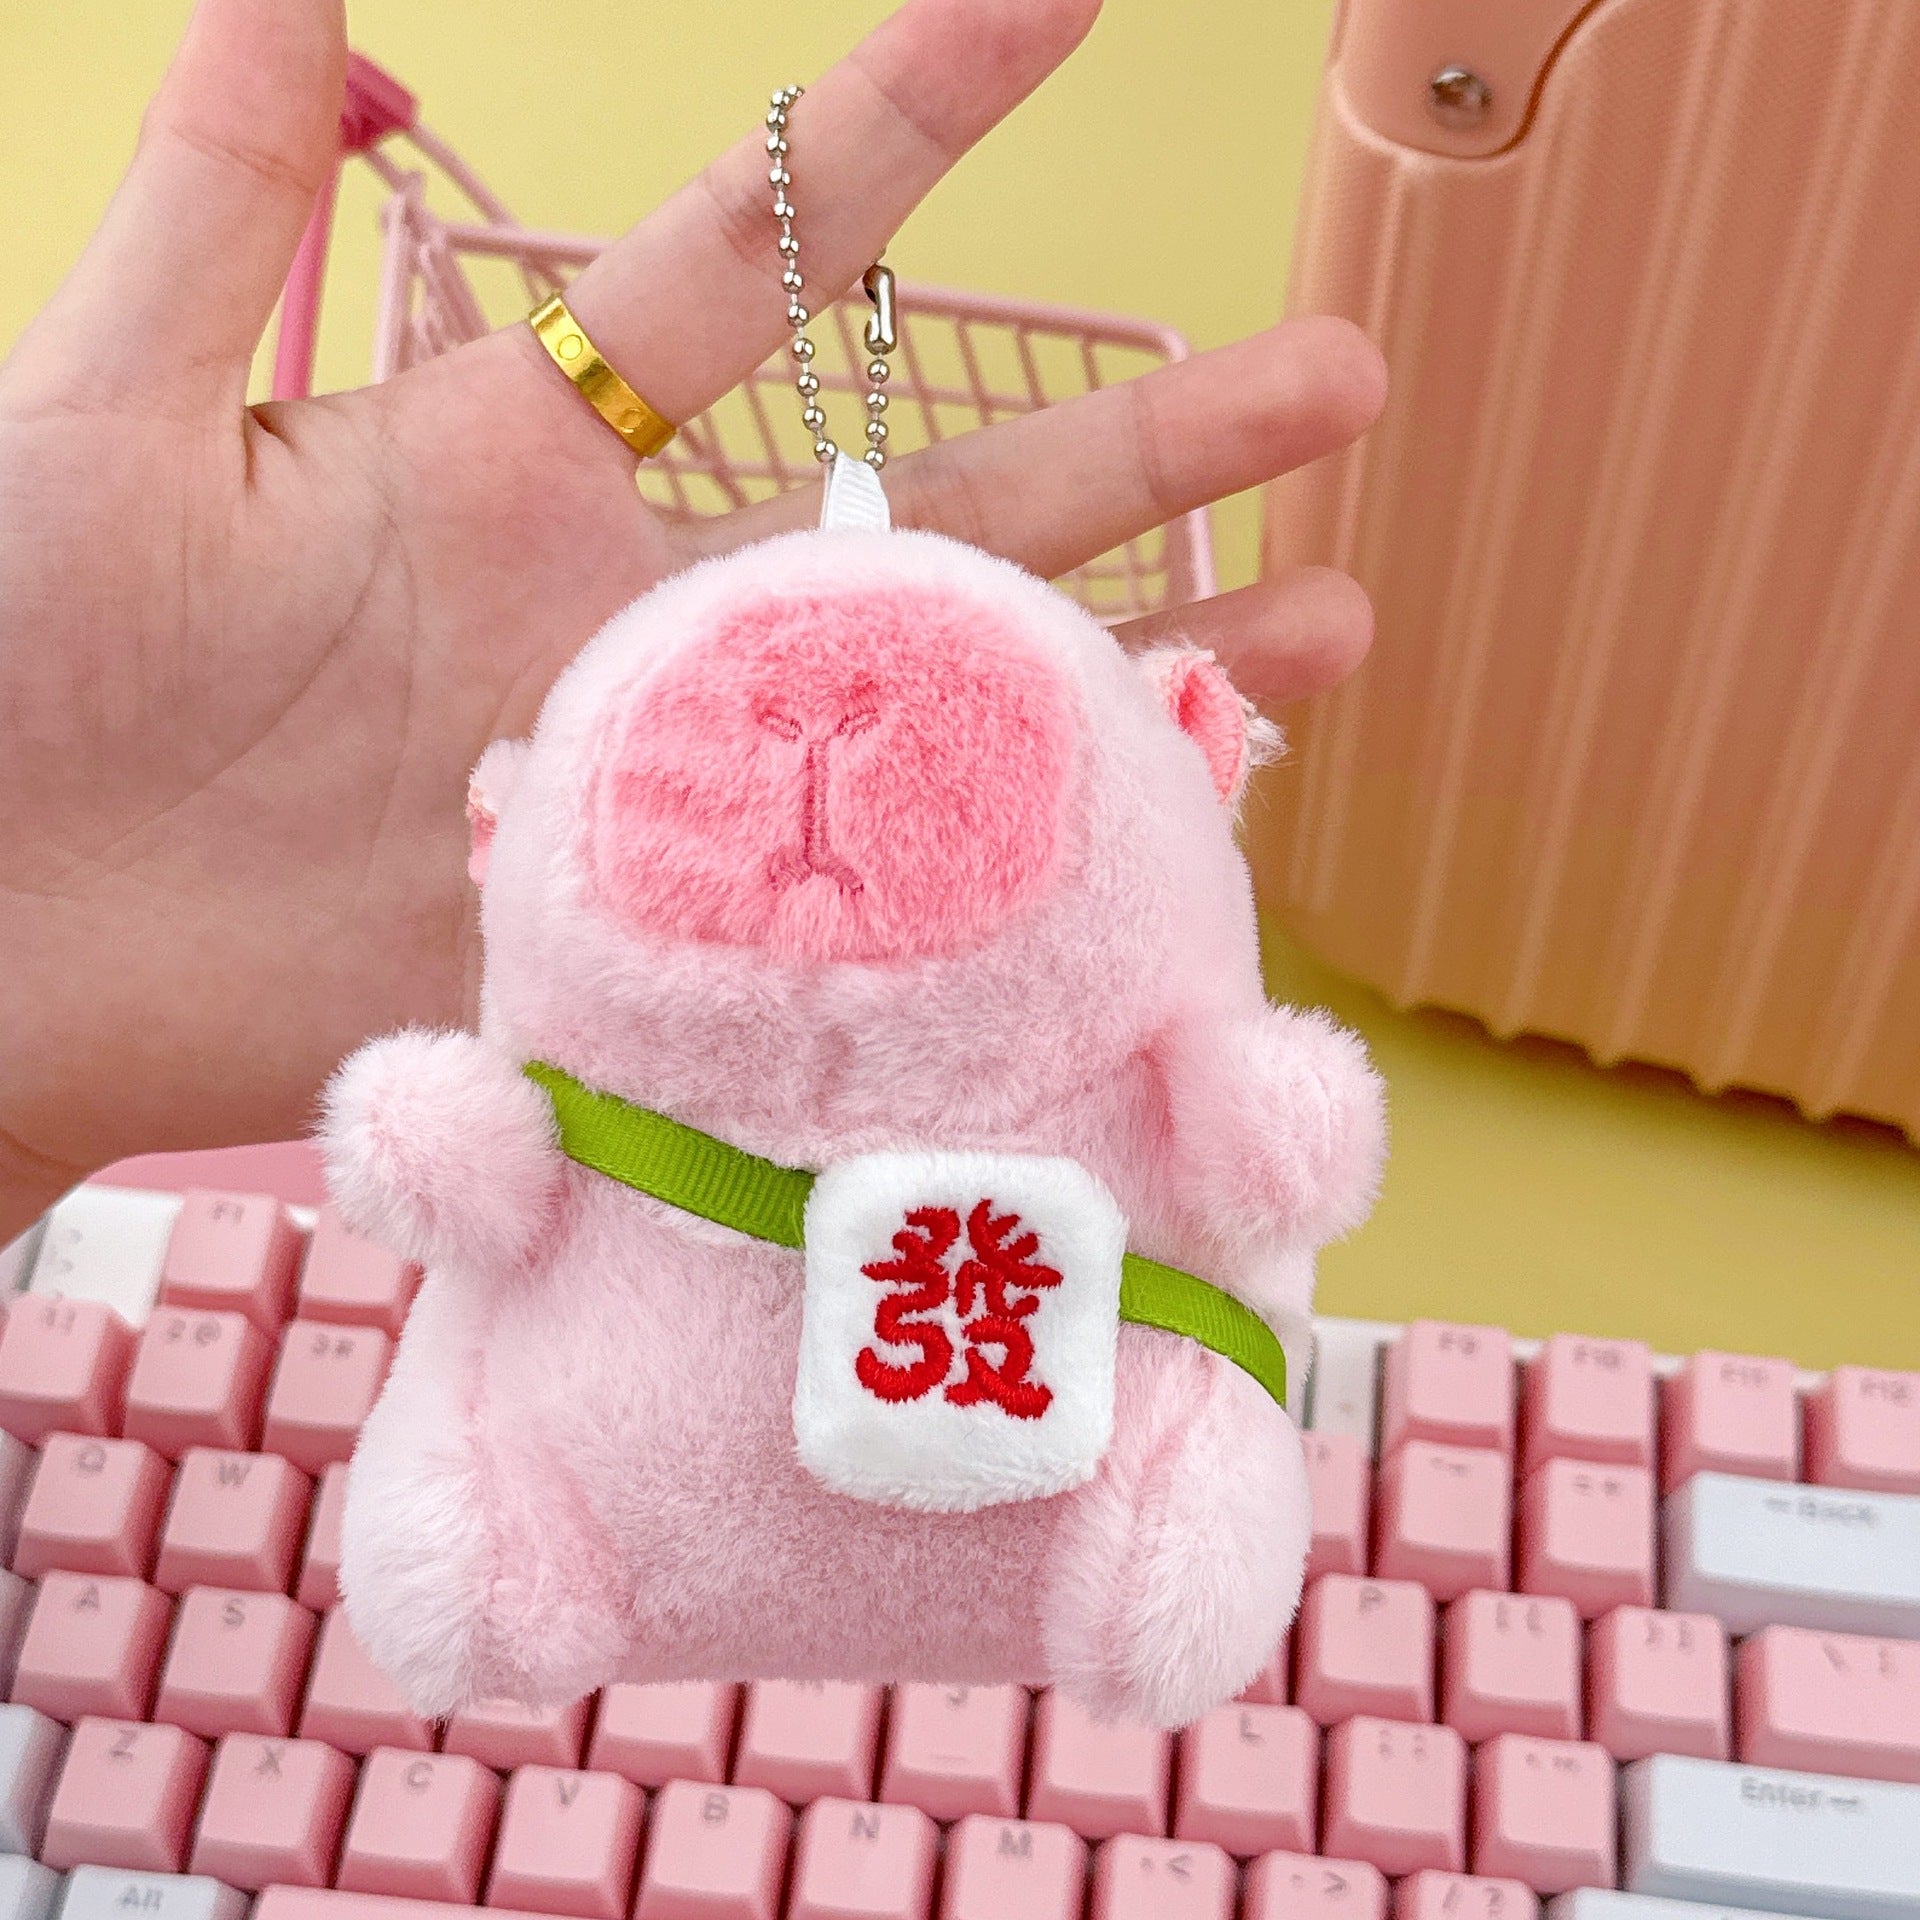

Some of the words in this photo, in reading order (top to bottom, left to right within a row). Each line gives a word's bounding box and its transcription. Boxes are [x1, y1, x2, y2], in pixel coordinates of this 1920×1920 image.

[855, 1199, 1064, 1420] 發
[217, 1460, 252, 1487] W
[75, 1582, 101, 1613] A
[222, 1597, 246, 1630] S
[1357, 1586, 1386, 1616] P
[110, 1727, 140, 1759] Z
[1238, 1711, 1266, 1744] L
[254, 1743, 286, 1776] X
[403, 1760, 435, 1795] C
[556, 1776, 581, 1807] V
[1741, 1777, 1822, 1811] Enter
[702, 1792, 731, 1824] B
[849, 1809, 881, 1842] N
[997, 1827, 1035, 1862] M
